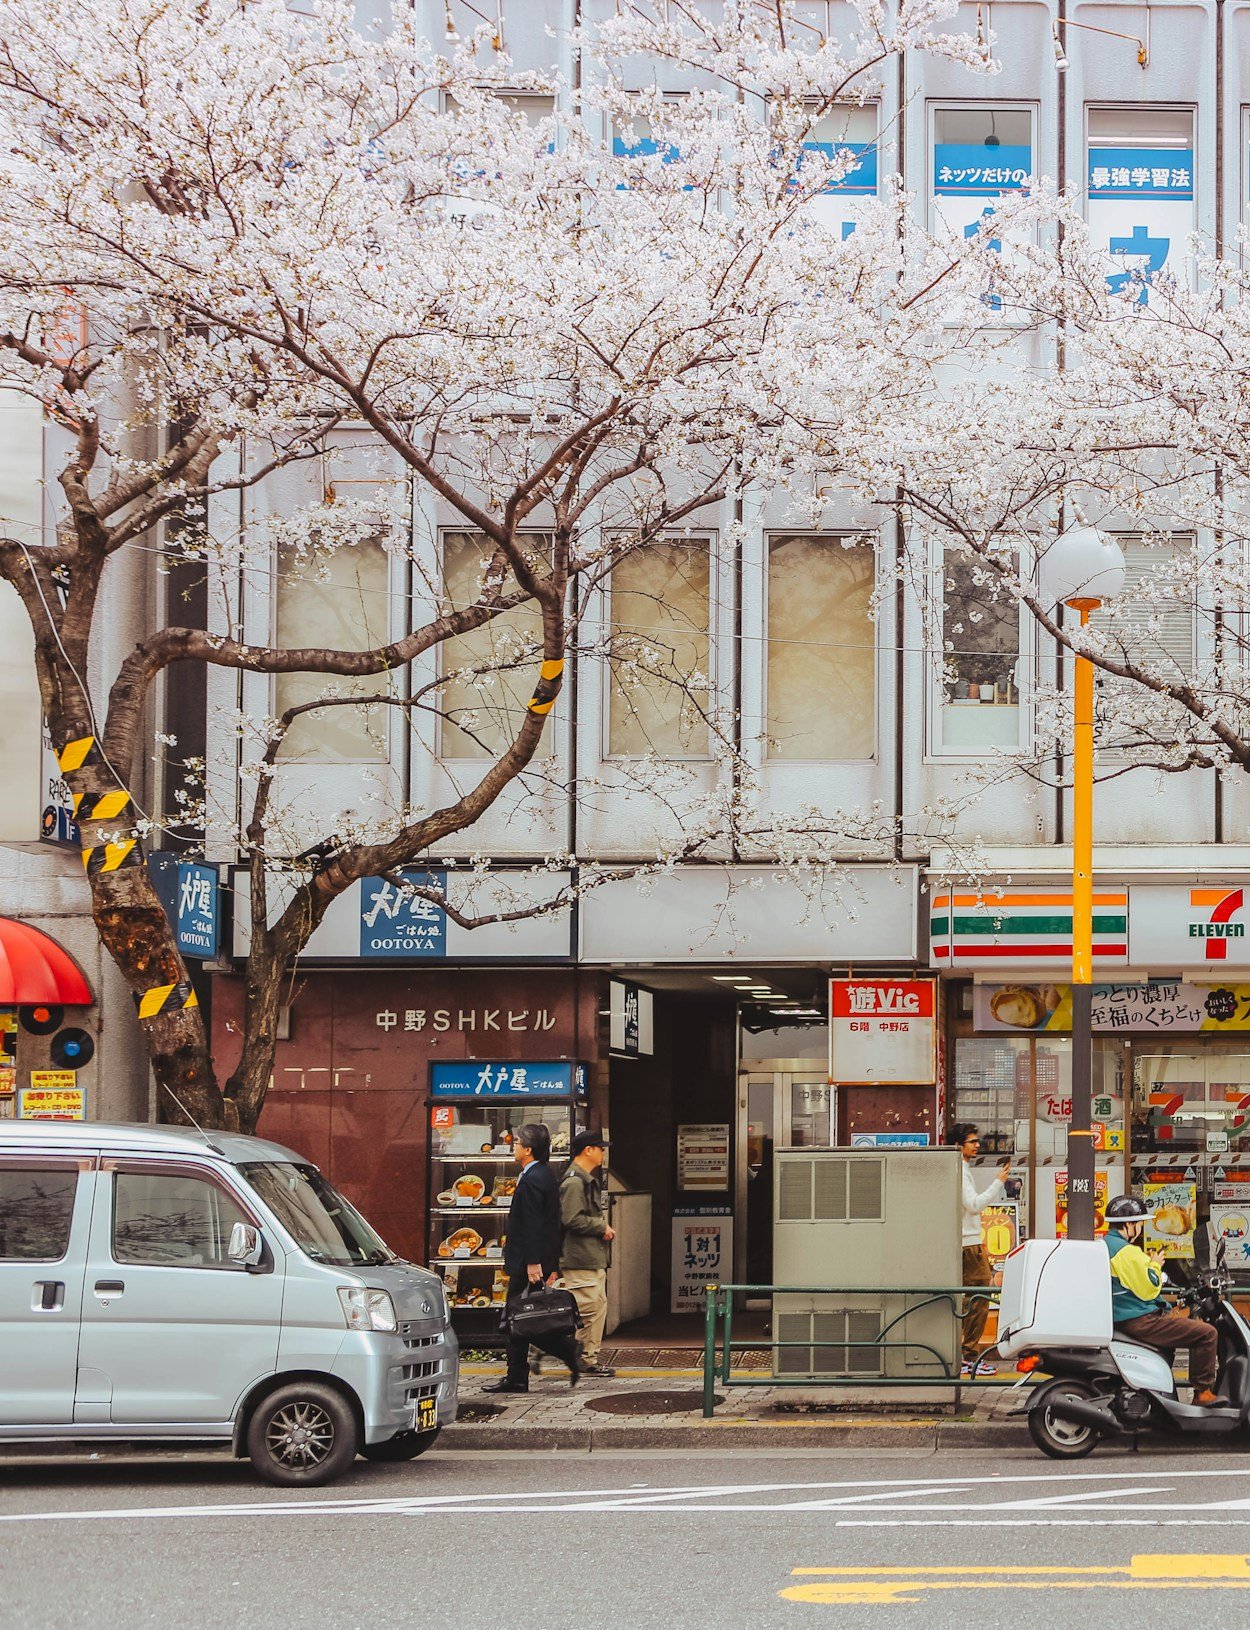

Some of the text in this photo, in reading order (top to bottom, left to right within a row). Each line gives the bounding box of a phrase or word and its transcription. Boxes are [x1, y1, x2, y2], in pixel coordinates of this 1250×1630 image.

[938, 166, 1028, 184] ネッツだけの
[1091, 167, 1190, 189] 最強学習法
[179, 871, 213, 919] 大戸屋
[362, 881, 441, 928] 大戸屋
[180, 931, 211, 948] OOTOYA
[371, 938, 435, 950] OOTOYA
[376, 1008, 556, 1032] 中野SHKビル
[1091, 1004, 1202, 1028] 至福のくちどけ
[850, 1021, 910, 1032] 6階 中野店
[475, 1064, 530, 1094] 大戸屋
[1047, 1098, 1113, 1116] たば 酒
[683, 1252, 720, 1269] ネッツ
[1115, 1352, 1139, 1361] GEAR
